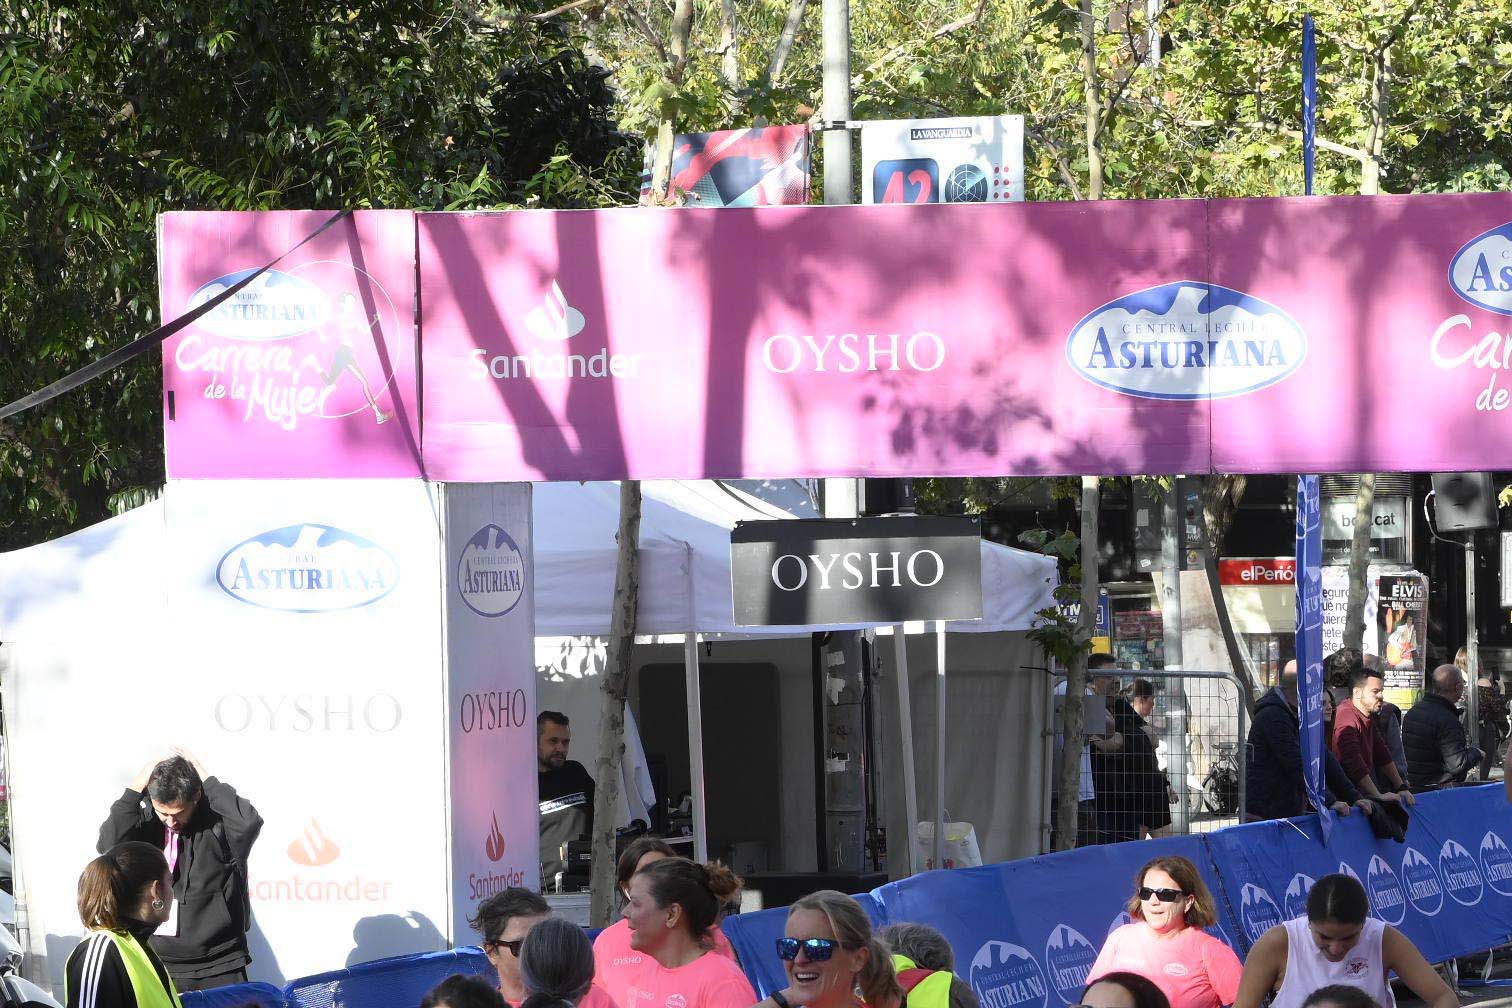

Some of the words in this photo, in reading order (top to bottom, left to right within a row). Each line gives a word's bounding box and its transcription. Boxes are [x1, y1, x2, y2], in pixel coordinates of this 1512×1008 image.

[912, 130, 923, 139] LA
[922, 127, 971, 139] VANGUARDIA
[1122, 323, 1197, 334] CENTRAL
[176, 335, 294, 372] Carrera
[471, 347, 642, 379] Santander
[763, 332, 946, 373] OYSHO
[1086, 327, 1287, 369] ASTURIANA
[204, 372, 226, 399] de
[230, 374, 246, 399] la
[246, 370, 336, 431] Mujer
[1475, 373, 1510, 411] de
[231, 557, 385, 590] ASTURIANA
[463, 559, 521, 594] ASTURIANA
[772, 550, 944, 591] OYSHO
[1392, 585, 1423, 598] ELVIS
[214, 693, 402, 733] OYSHO
[460, 689, 527, 733] OYSHO
[1408, 879, 1441, 901] ASTURIANA
